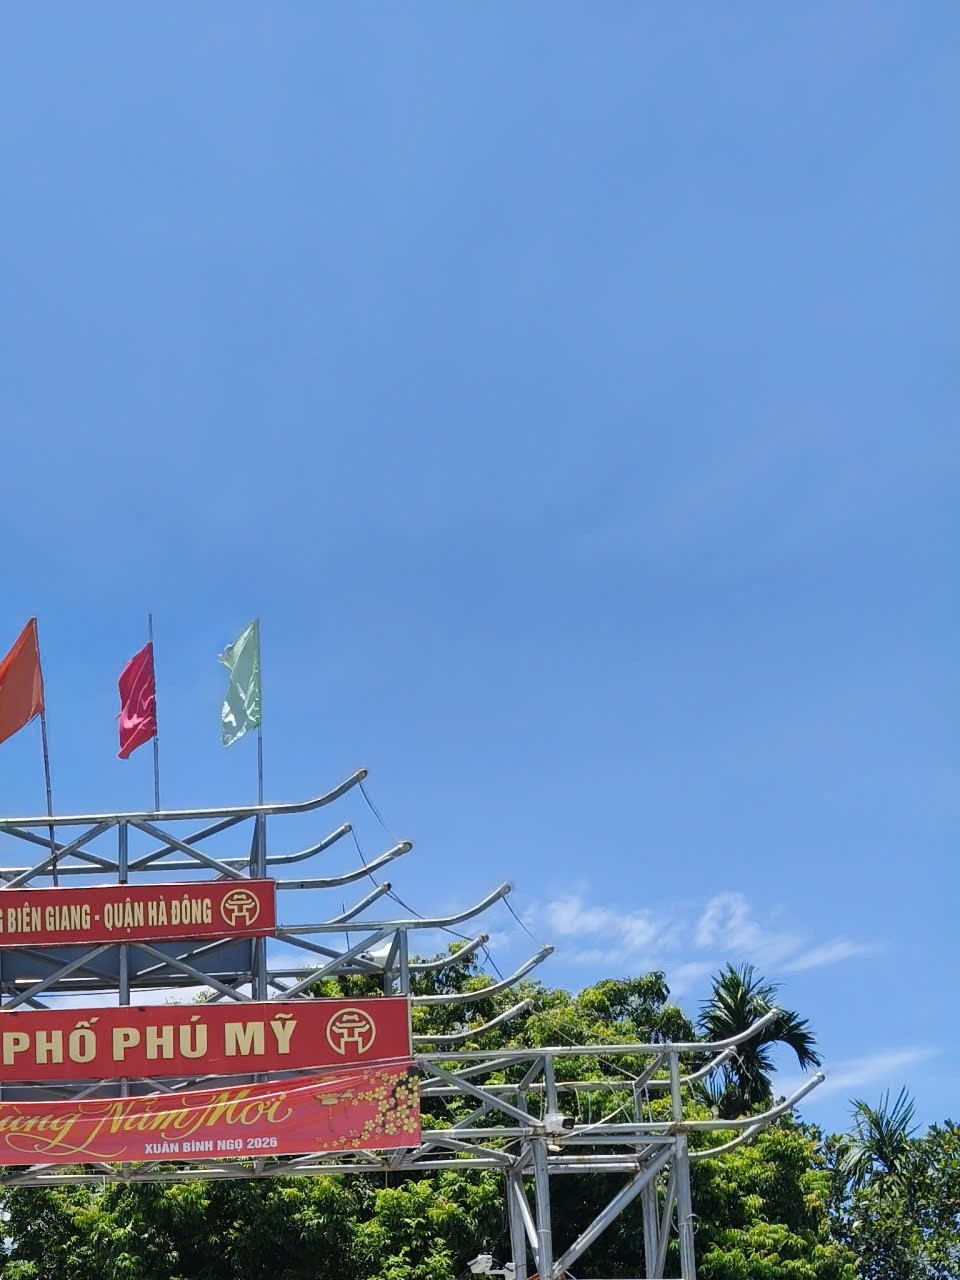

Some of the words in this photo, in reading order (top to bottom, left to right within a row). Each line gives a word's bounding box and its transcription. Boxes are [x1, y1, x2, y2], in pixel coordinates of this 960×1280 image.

[7, 901, 42, 933] BIÊN
[45, 904, 91, 932] GIANG
[103, 896, 145, 933] QUẬN
[147, 895, 168, 926] HÀ
[170, 893, 212, 926] ĐÔNG
[2, 1016, 100, 1066] PHỐ
[112, 1014, 208, 1062] PHÚ
[224, 1012, 298, 1057] MỸ
[144, 1142, 180, 1154] XUÂN
[182, 1139, 213, 1153] BÍNH
[217, 1138, 243, 1152] NGỌ
[246, 1136, 278, 1149] 2026
